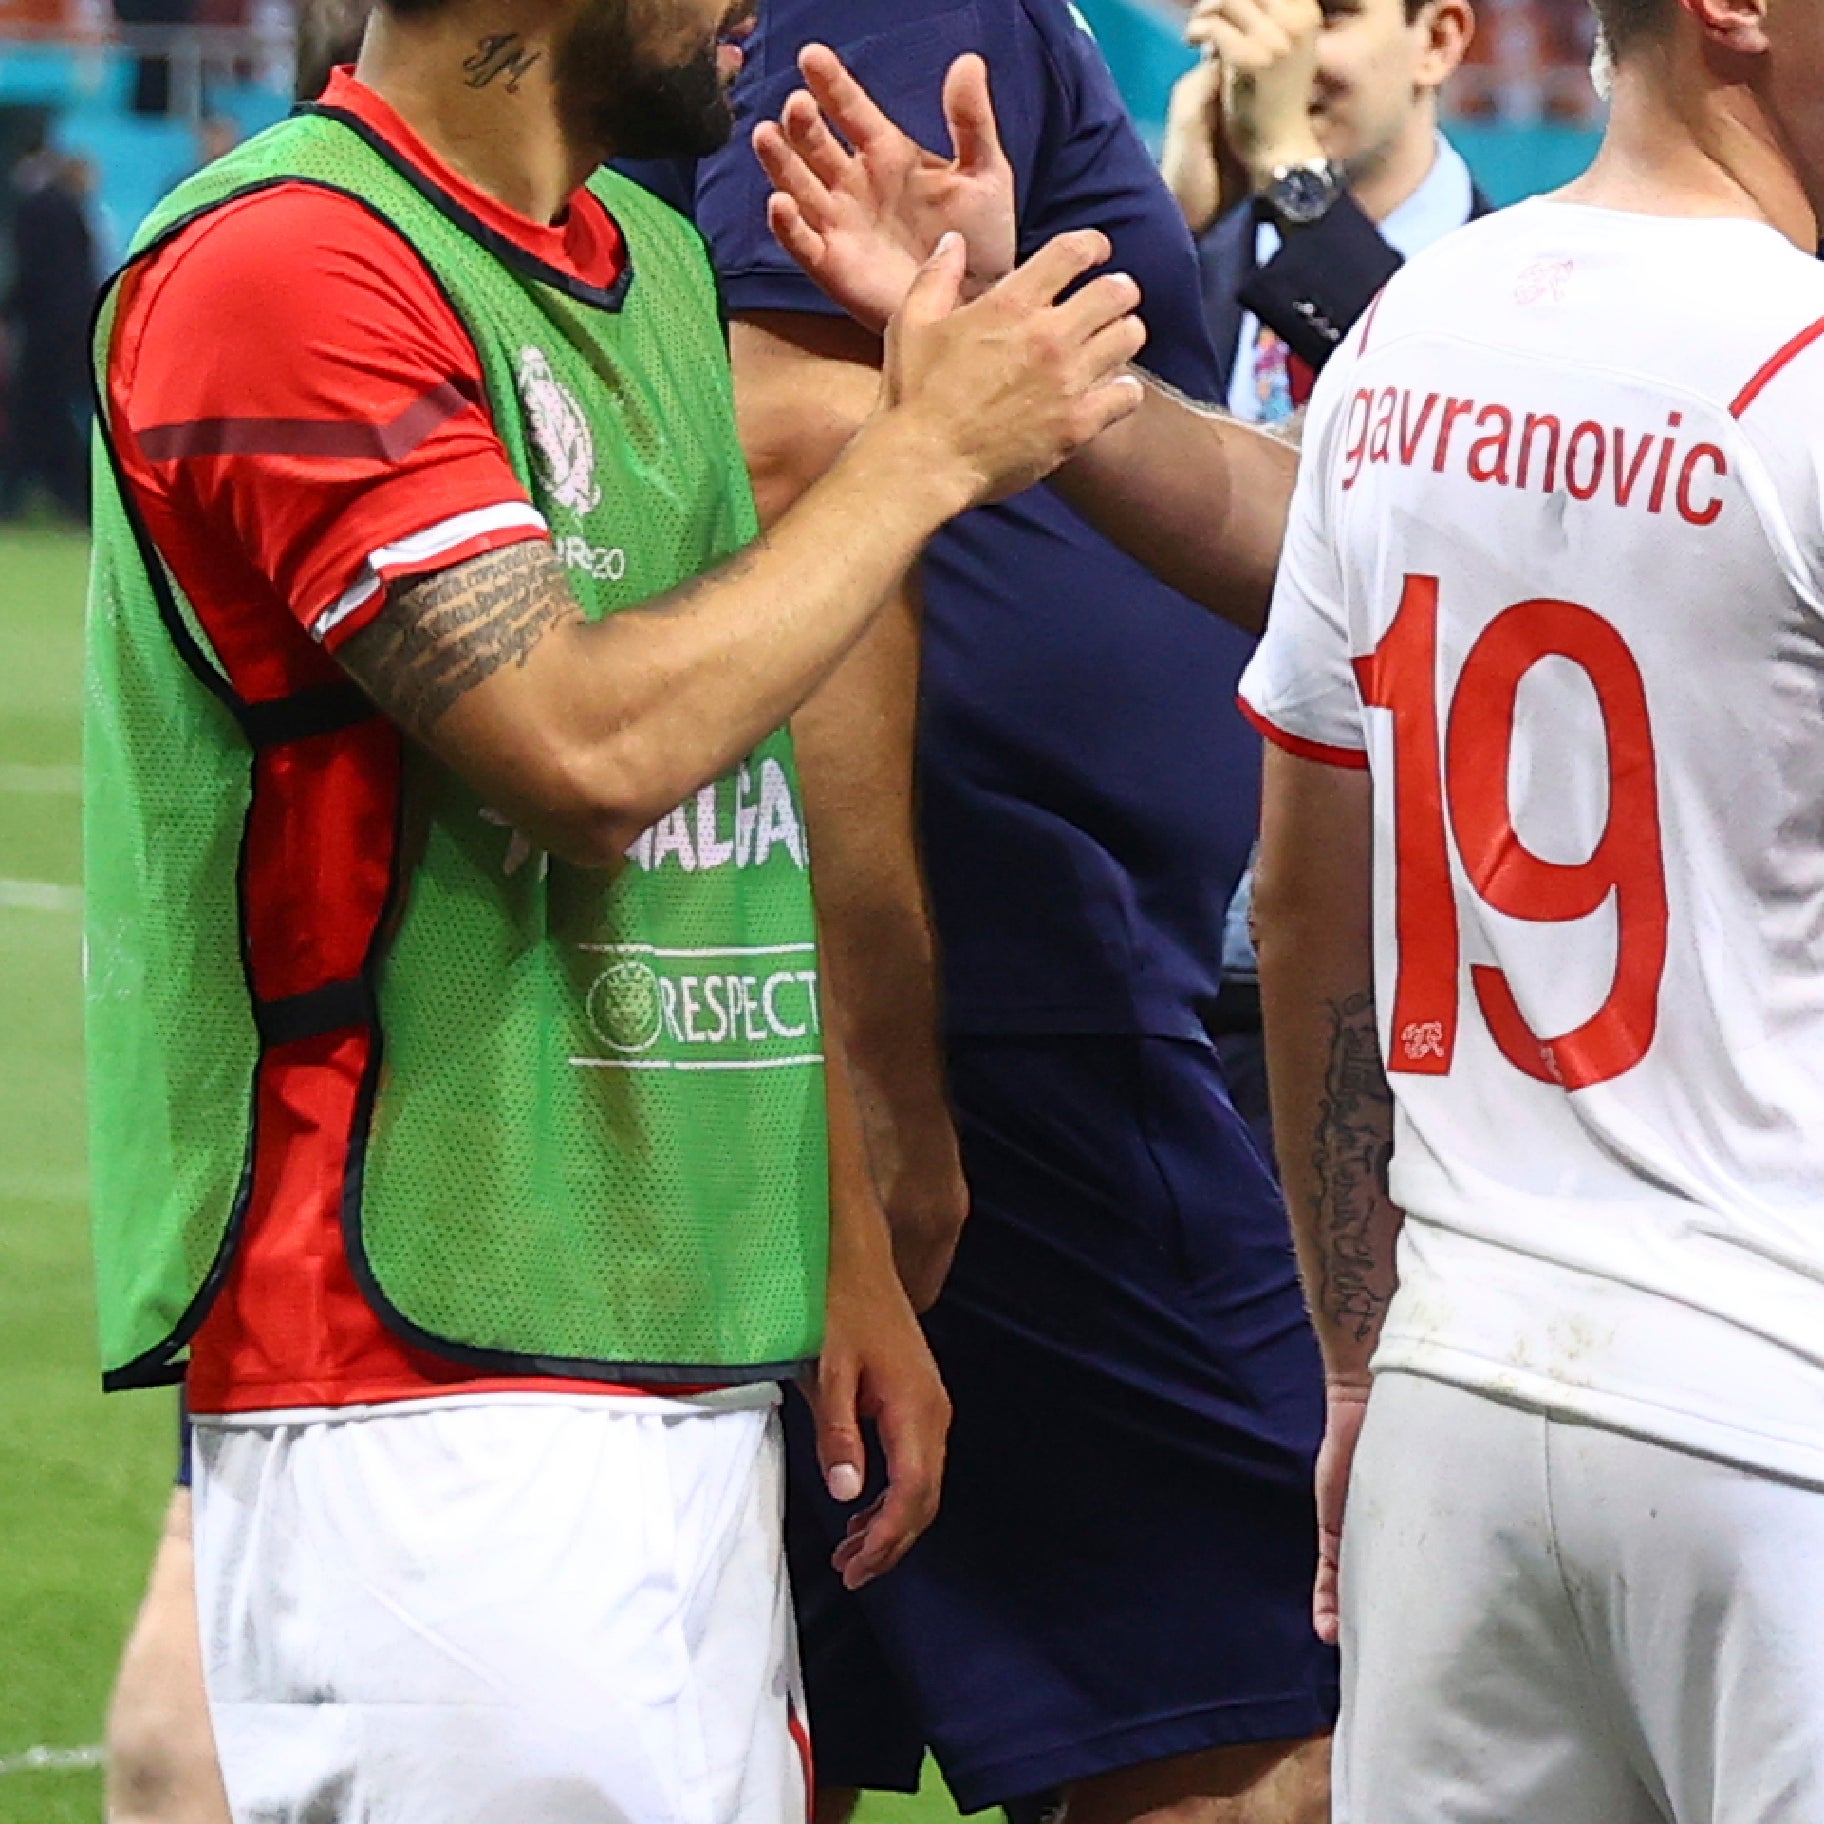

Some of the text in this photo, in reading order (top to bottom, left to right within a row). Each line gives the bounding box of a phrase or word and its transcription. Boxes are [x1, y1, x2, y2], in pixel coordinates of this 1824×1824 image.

[1341, 386, 1728, 526] gavranovic
[1351, 572, 1670, 1092] 19
[658, 971, 819, 1042] RESPECT
